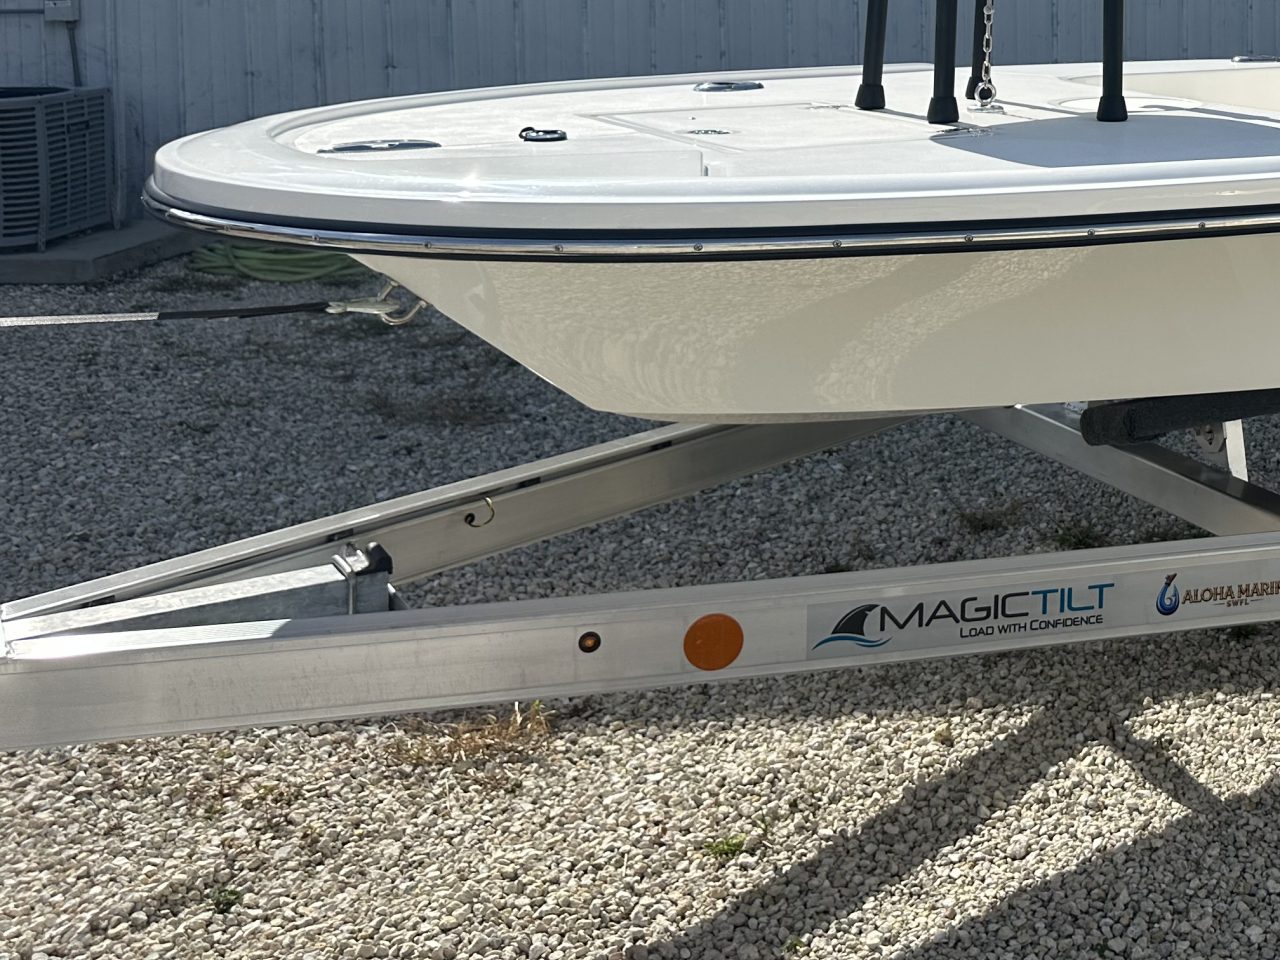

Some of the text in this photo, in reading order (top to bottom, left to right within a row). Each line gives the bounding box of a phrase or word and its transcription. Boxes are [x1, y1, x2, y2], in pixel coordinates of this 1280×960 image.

[1181, 584, 1235, 604] ALOHA
[1226, 599, 1250, 608] SWFL
[879, 582, 1115, 632] MAGICTILT
[959, 614, 1104, 638] LOAD WITH CONFIDENCE
